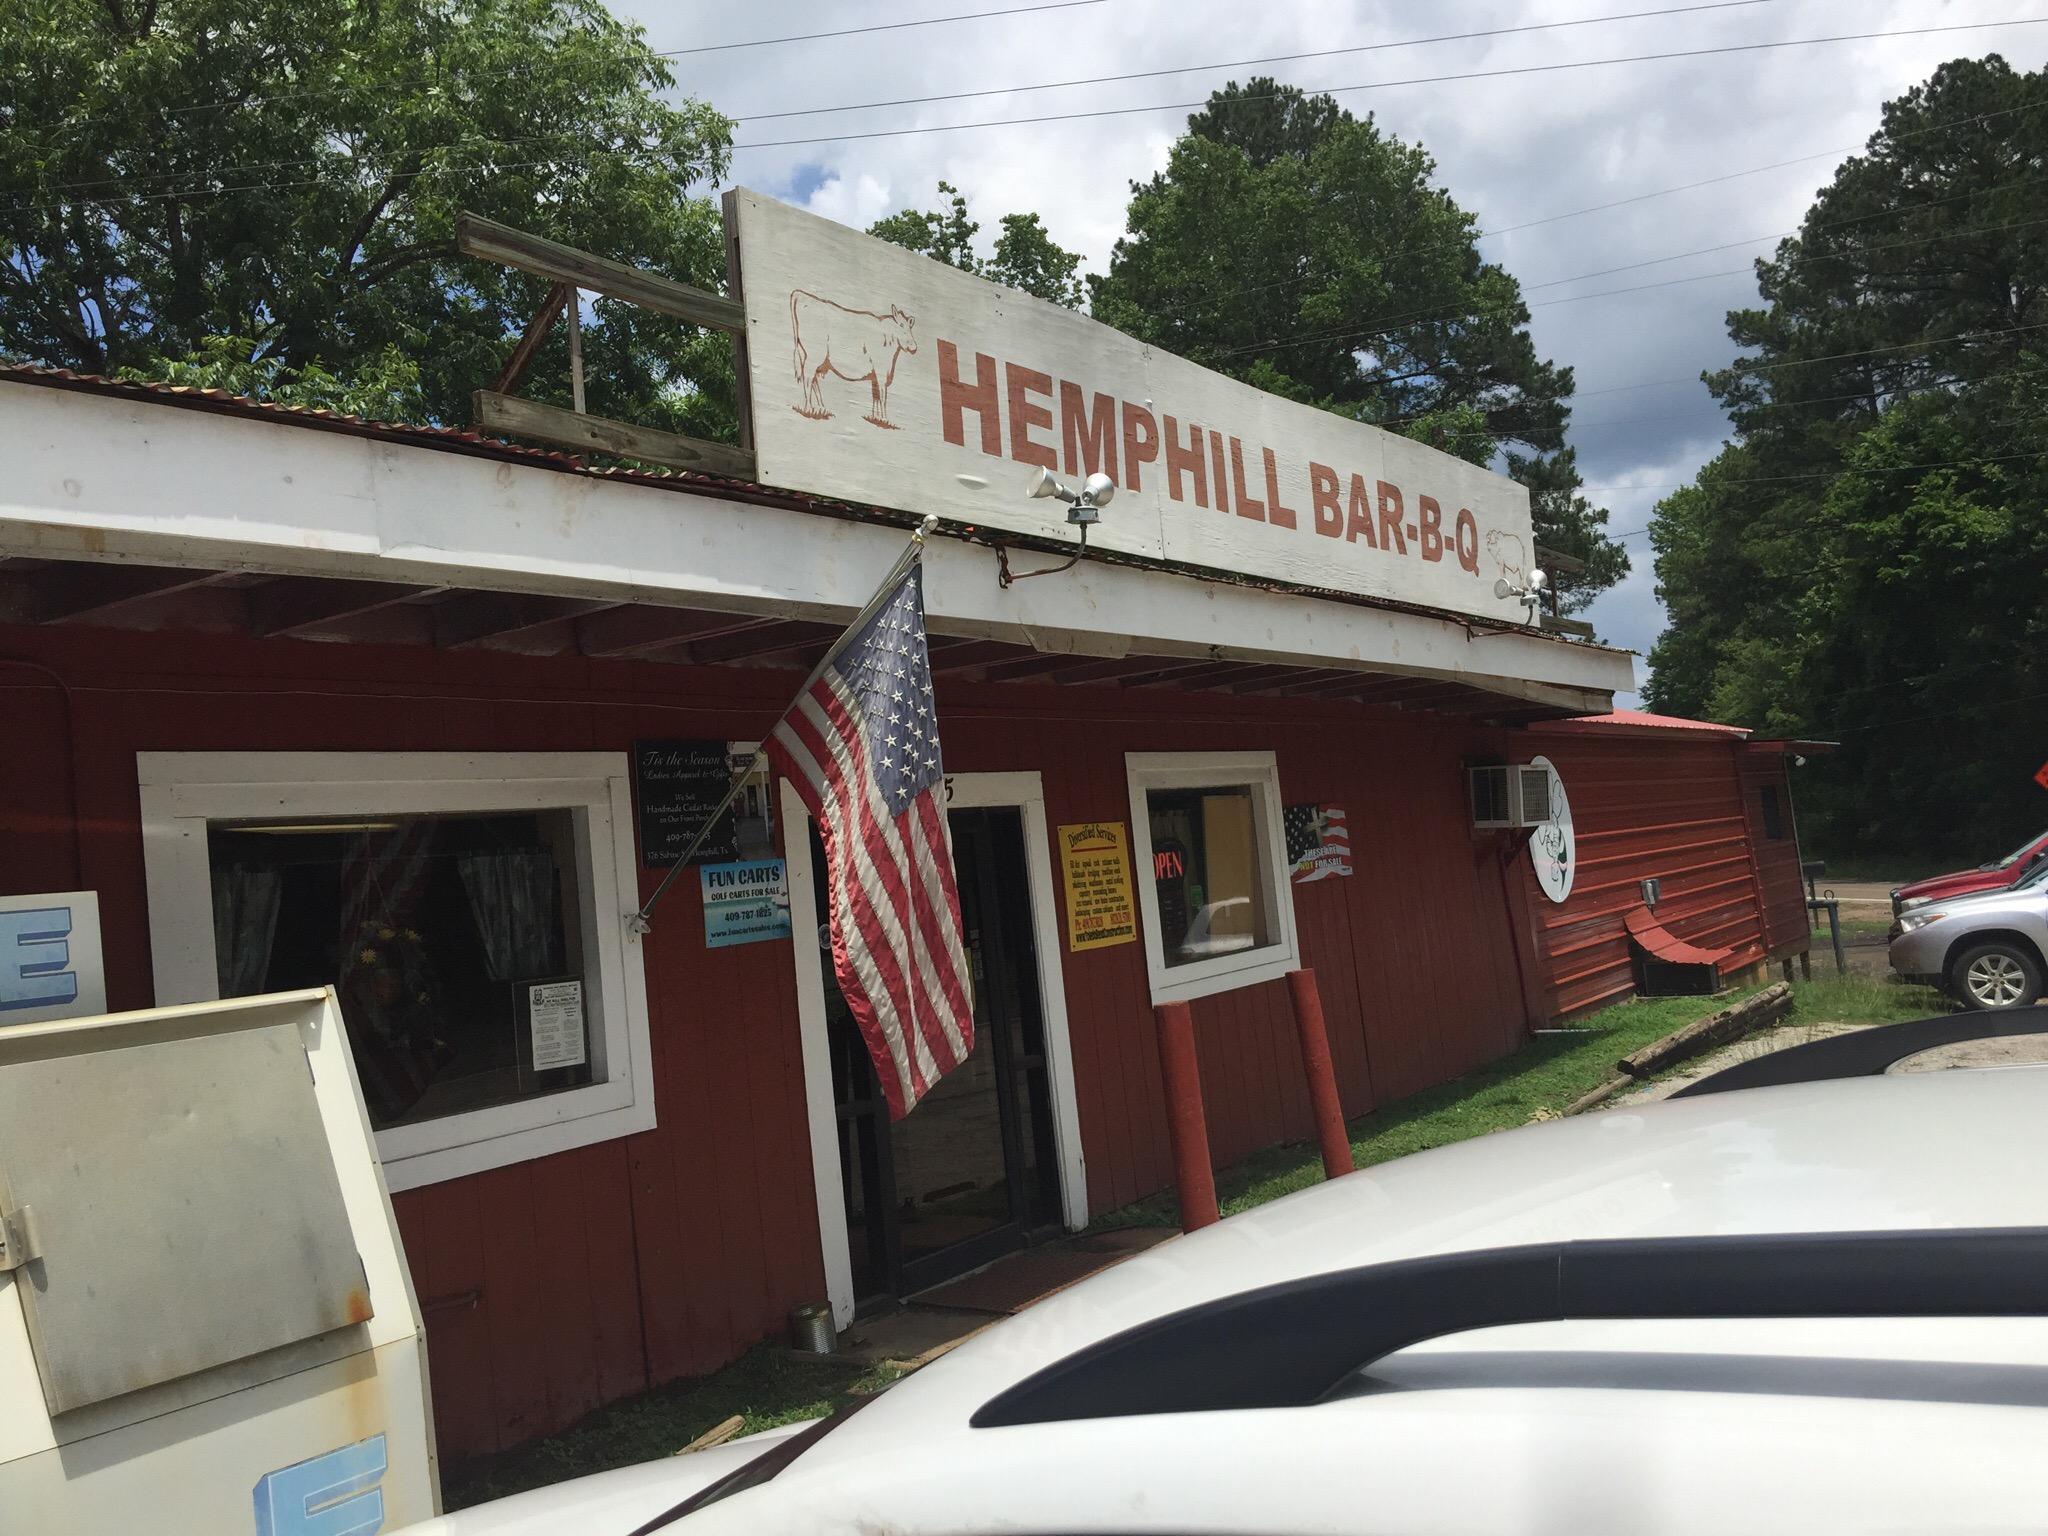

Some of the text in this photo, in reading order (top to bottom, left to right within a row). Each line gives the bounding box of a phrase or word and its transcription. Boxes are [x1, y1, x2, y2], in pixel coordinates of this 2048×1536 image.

[937, 338, 1480, 578] HEMPHILL BAR-B-Q
[666, 752, 681, 766] the
[685, 751, 720, 766] Season
[646, 804, 682, 814] Handmade
[1067, 824, 1117, 848] Diversified Services
[1304, 845, 1337, 858] THESE ARE
[1299, 856, 1342, 872] NOT FOR SALE
[708, 866, 780, 887] FUN CARTS
[711, 886, 780, 901] GOLF CARTS FOR SALE
